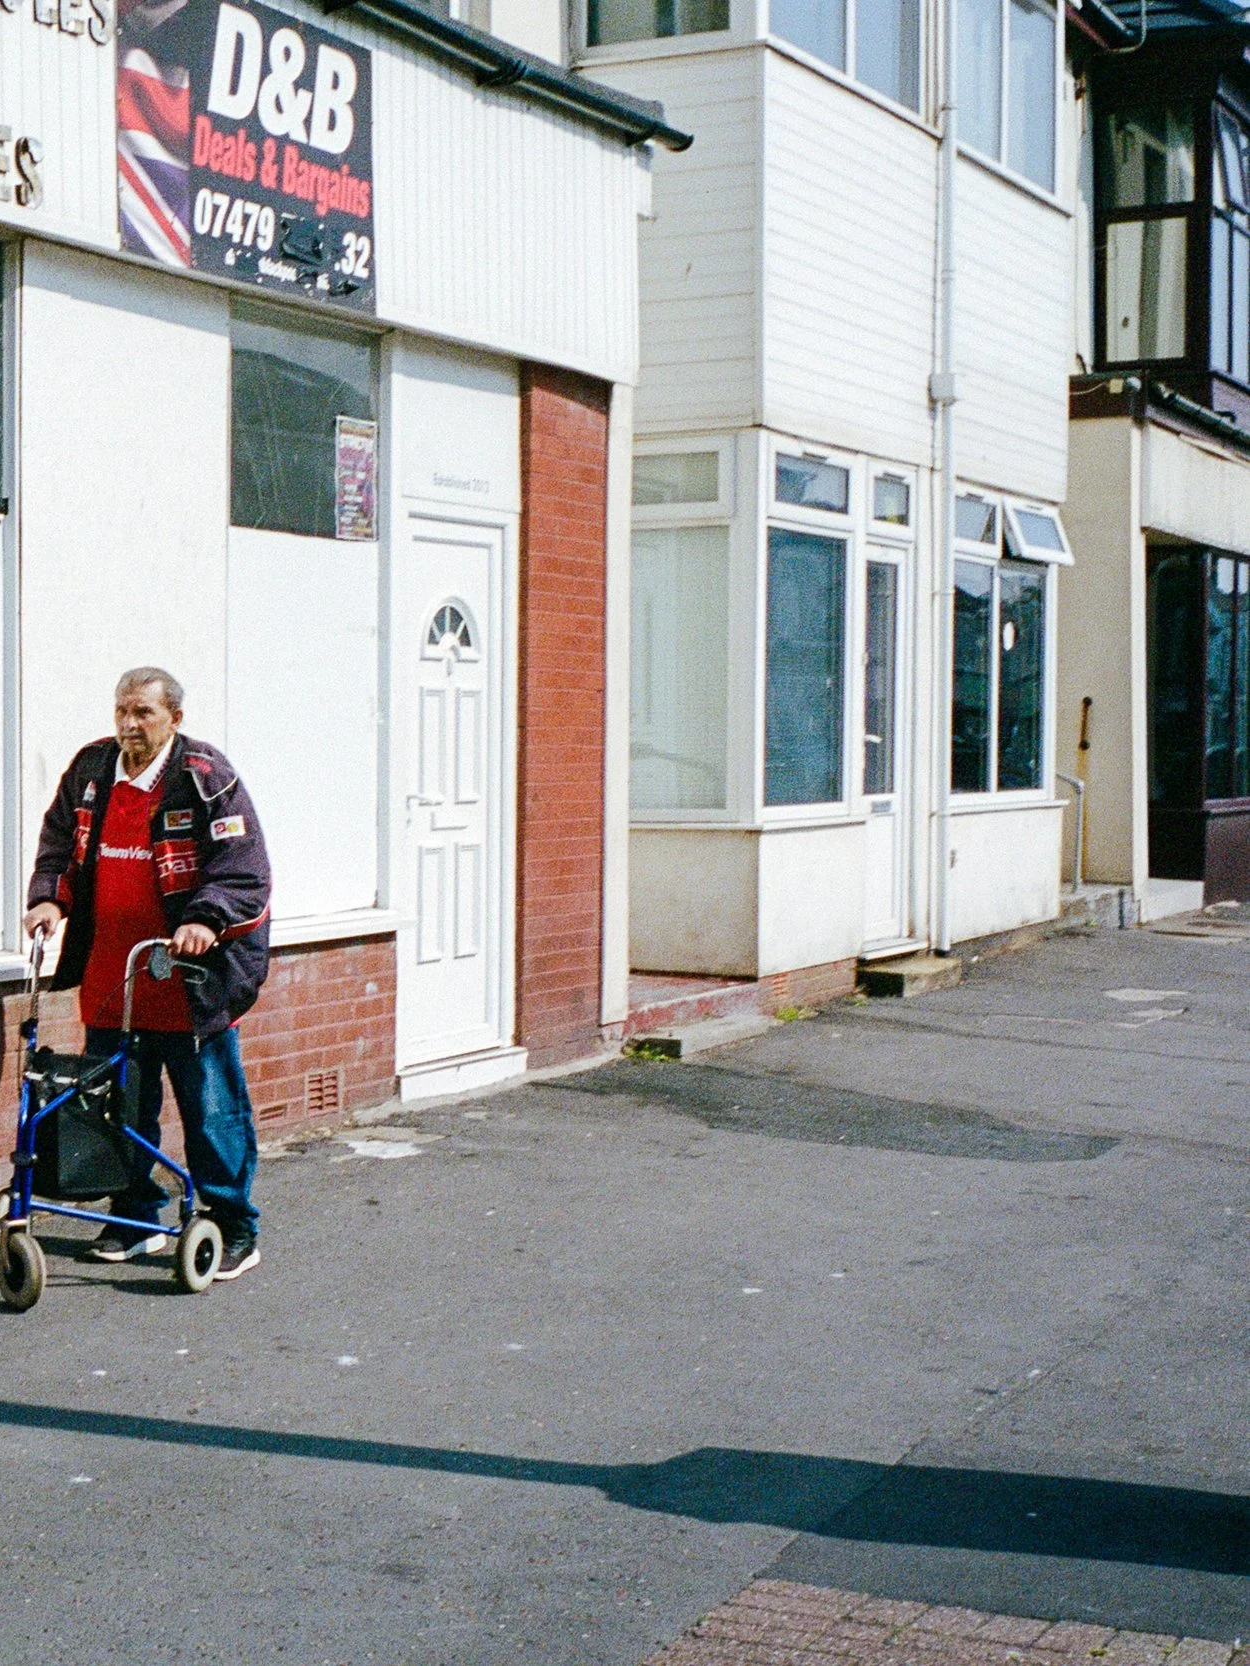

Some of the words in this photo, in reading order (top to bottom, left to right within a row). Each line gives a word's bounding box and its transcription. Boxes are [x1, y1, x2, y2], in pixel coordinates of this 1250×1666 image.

[206, 2, 358, 154] D&B
[192, 114, 258, 182] Deals
[260, 136, 279, 190] &
[282, 143, 372, 218] Bargains
[193, 187, 276, 252] 07479
